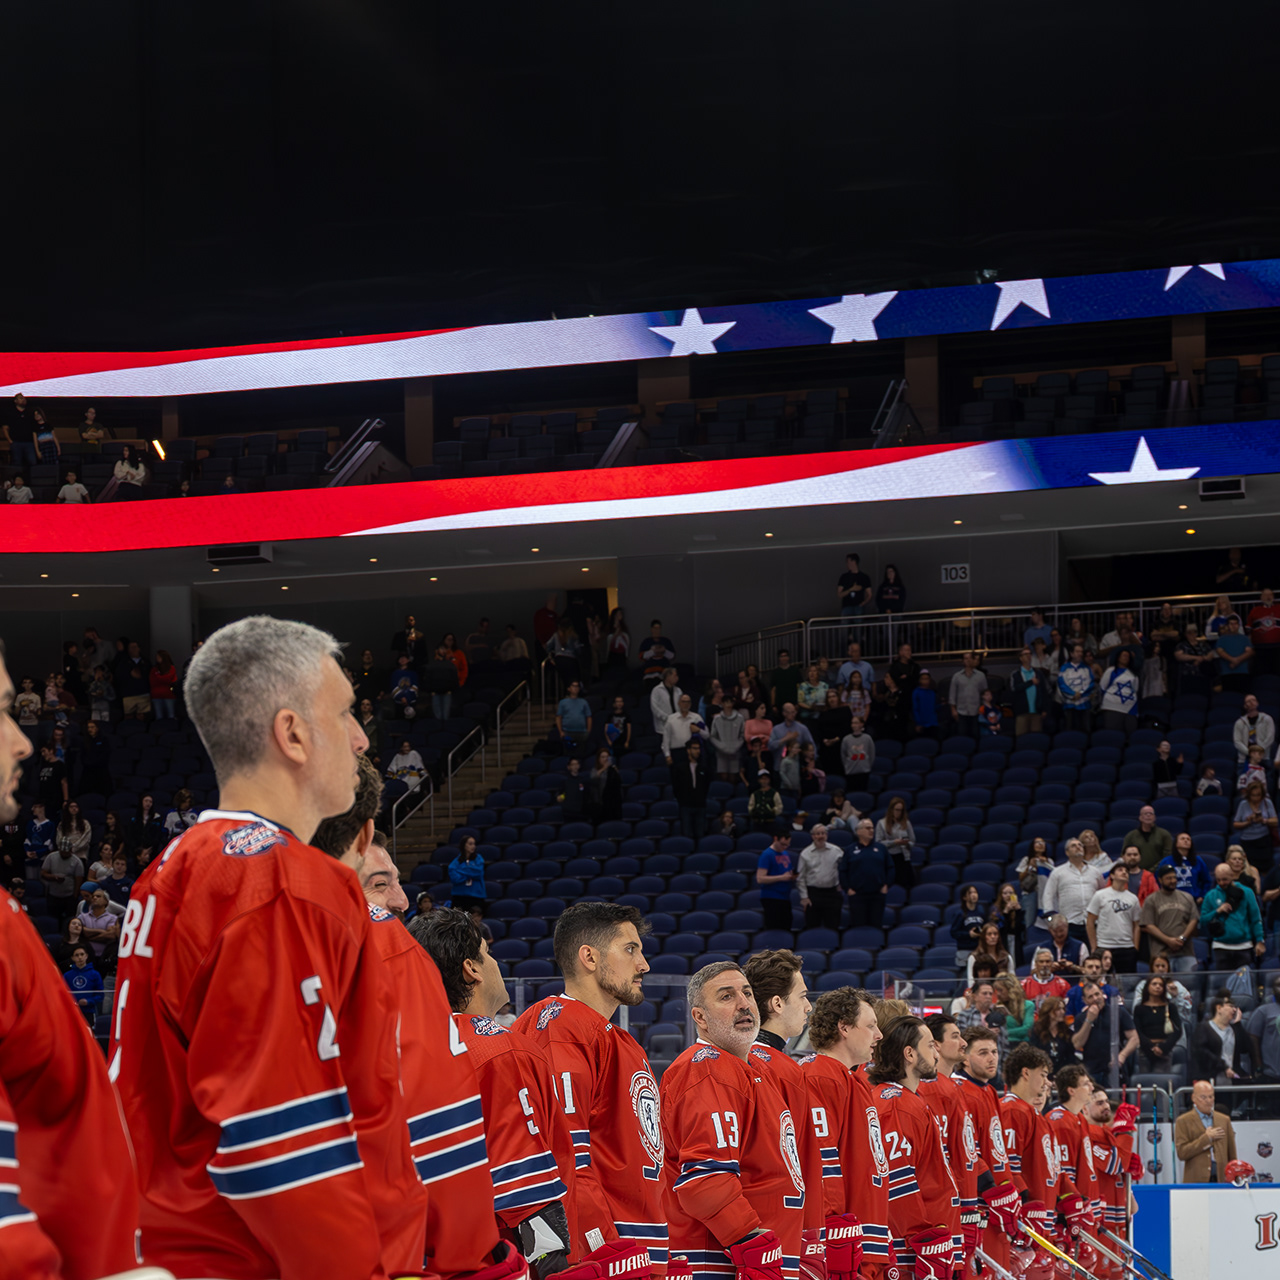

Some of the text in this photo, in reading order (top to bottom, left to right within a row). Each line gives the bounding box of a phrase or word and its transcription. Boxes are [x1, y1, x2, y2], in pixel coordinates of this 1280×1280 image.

[942, 566, 968, 581] 103
[711, 1111, 740, 1148] 13
[885, 1131, 912, 1161] 24
